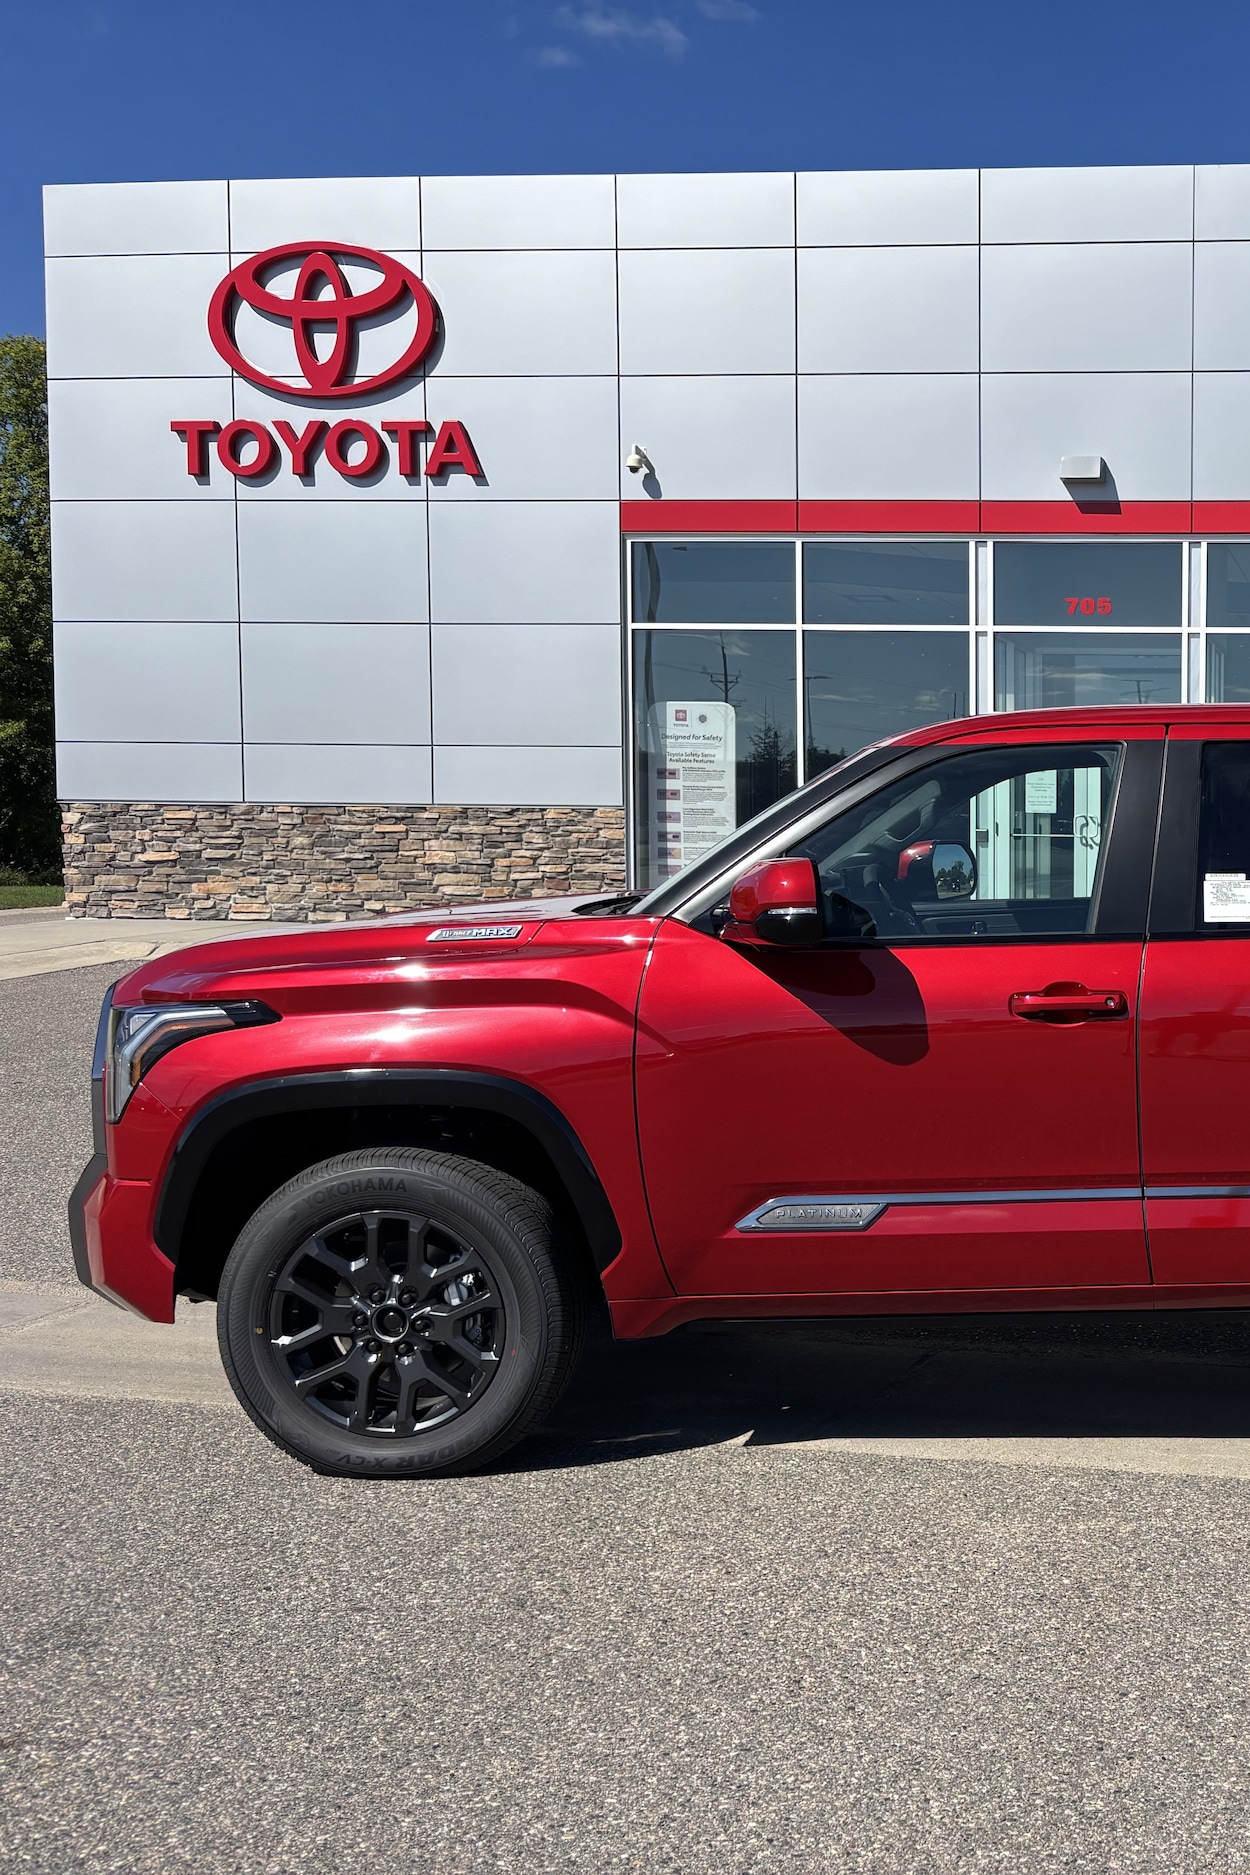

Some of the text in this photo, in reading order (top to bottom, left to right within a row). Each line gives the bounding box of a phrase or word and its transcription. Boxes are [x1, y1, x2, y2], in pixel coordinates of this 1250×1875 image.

[170, 418, 485, 476] TOYOTA
[1064, 597, 1112, 615] 705
[661, 734, 691, 742] Designed
[702, 734, 723, 743] Safety
[472, 927, 512, 937] MAX
[302, 1177, 407, 1208] YOKOHAMA
[775, 1208, 863, 1219] PLATINUM
